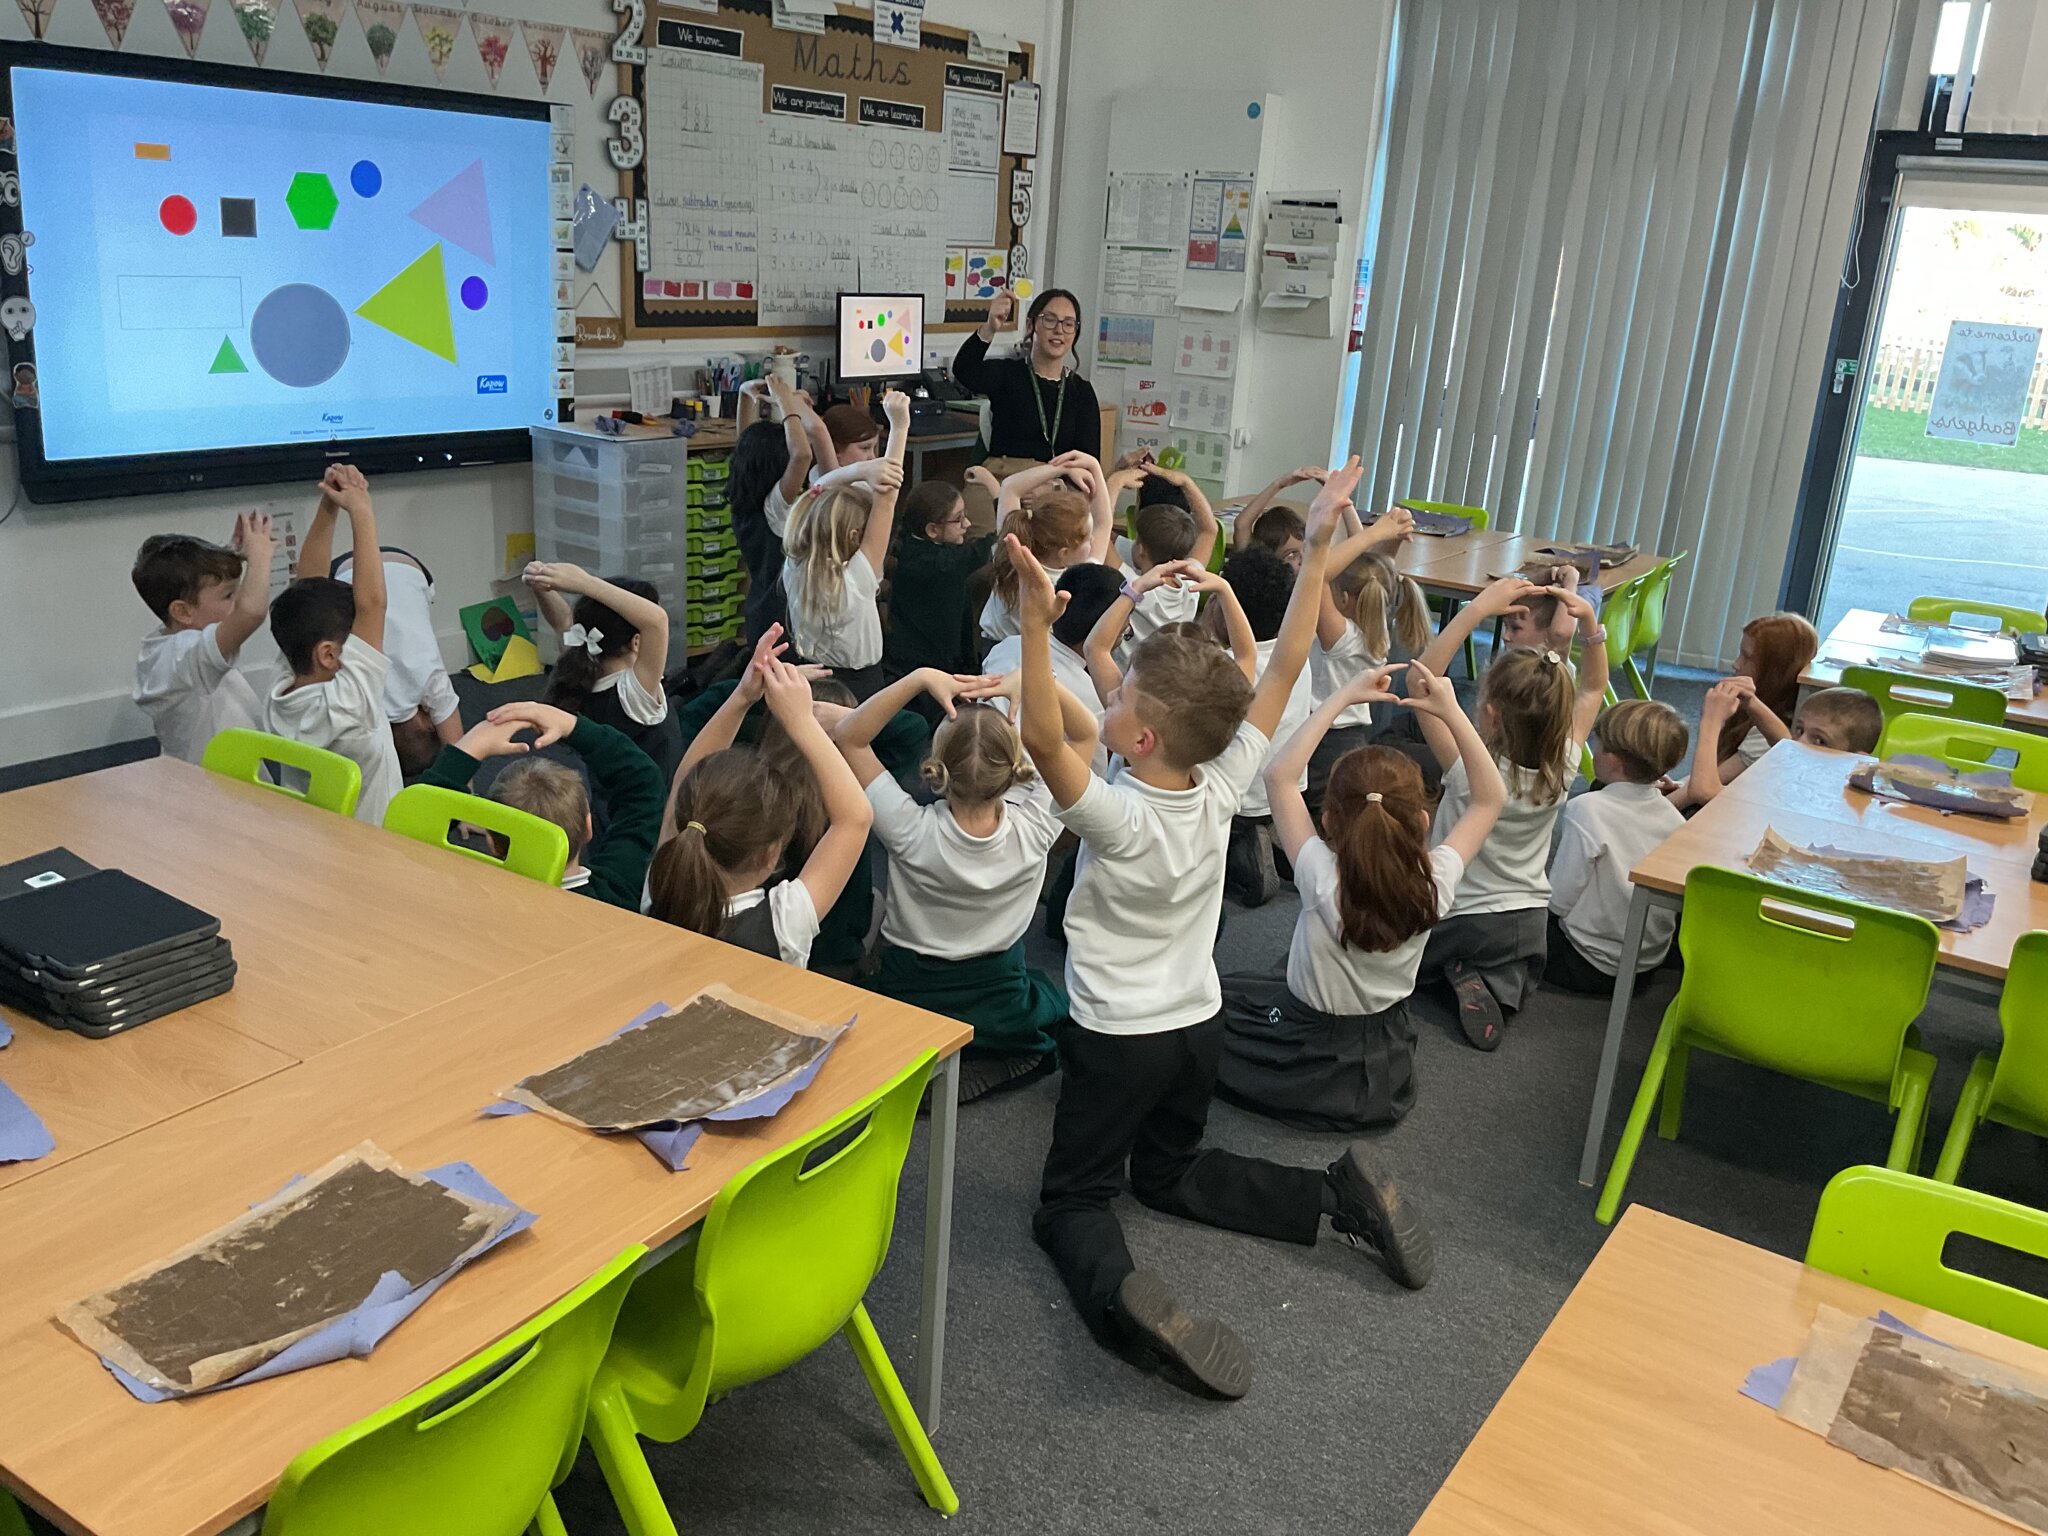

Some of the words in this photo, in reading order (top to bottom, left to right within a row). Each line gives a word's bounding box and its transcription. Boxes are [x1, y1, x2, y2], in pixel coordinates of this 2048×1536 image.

[677, 25, 694, 43] We
[793, 34, 912, 86] Maths
[948, 68, 961, 85] Key
[773, 90, 790, 106] We
[791, 98, 805, 108] are
[862, 102, 876, 116] We
[877, 109, 890, 118] are
[1012, 169, 1034, 228] 5
[613, 196, 651, 272] 4
[480, 377, 506, 391] Kapow
[1139, 379, 1156, 391] BEST
[322, 413, 344, 423] Kapow
